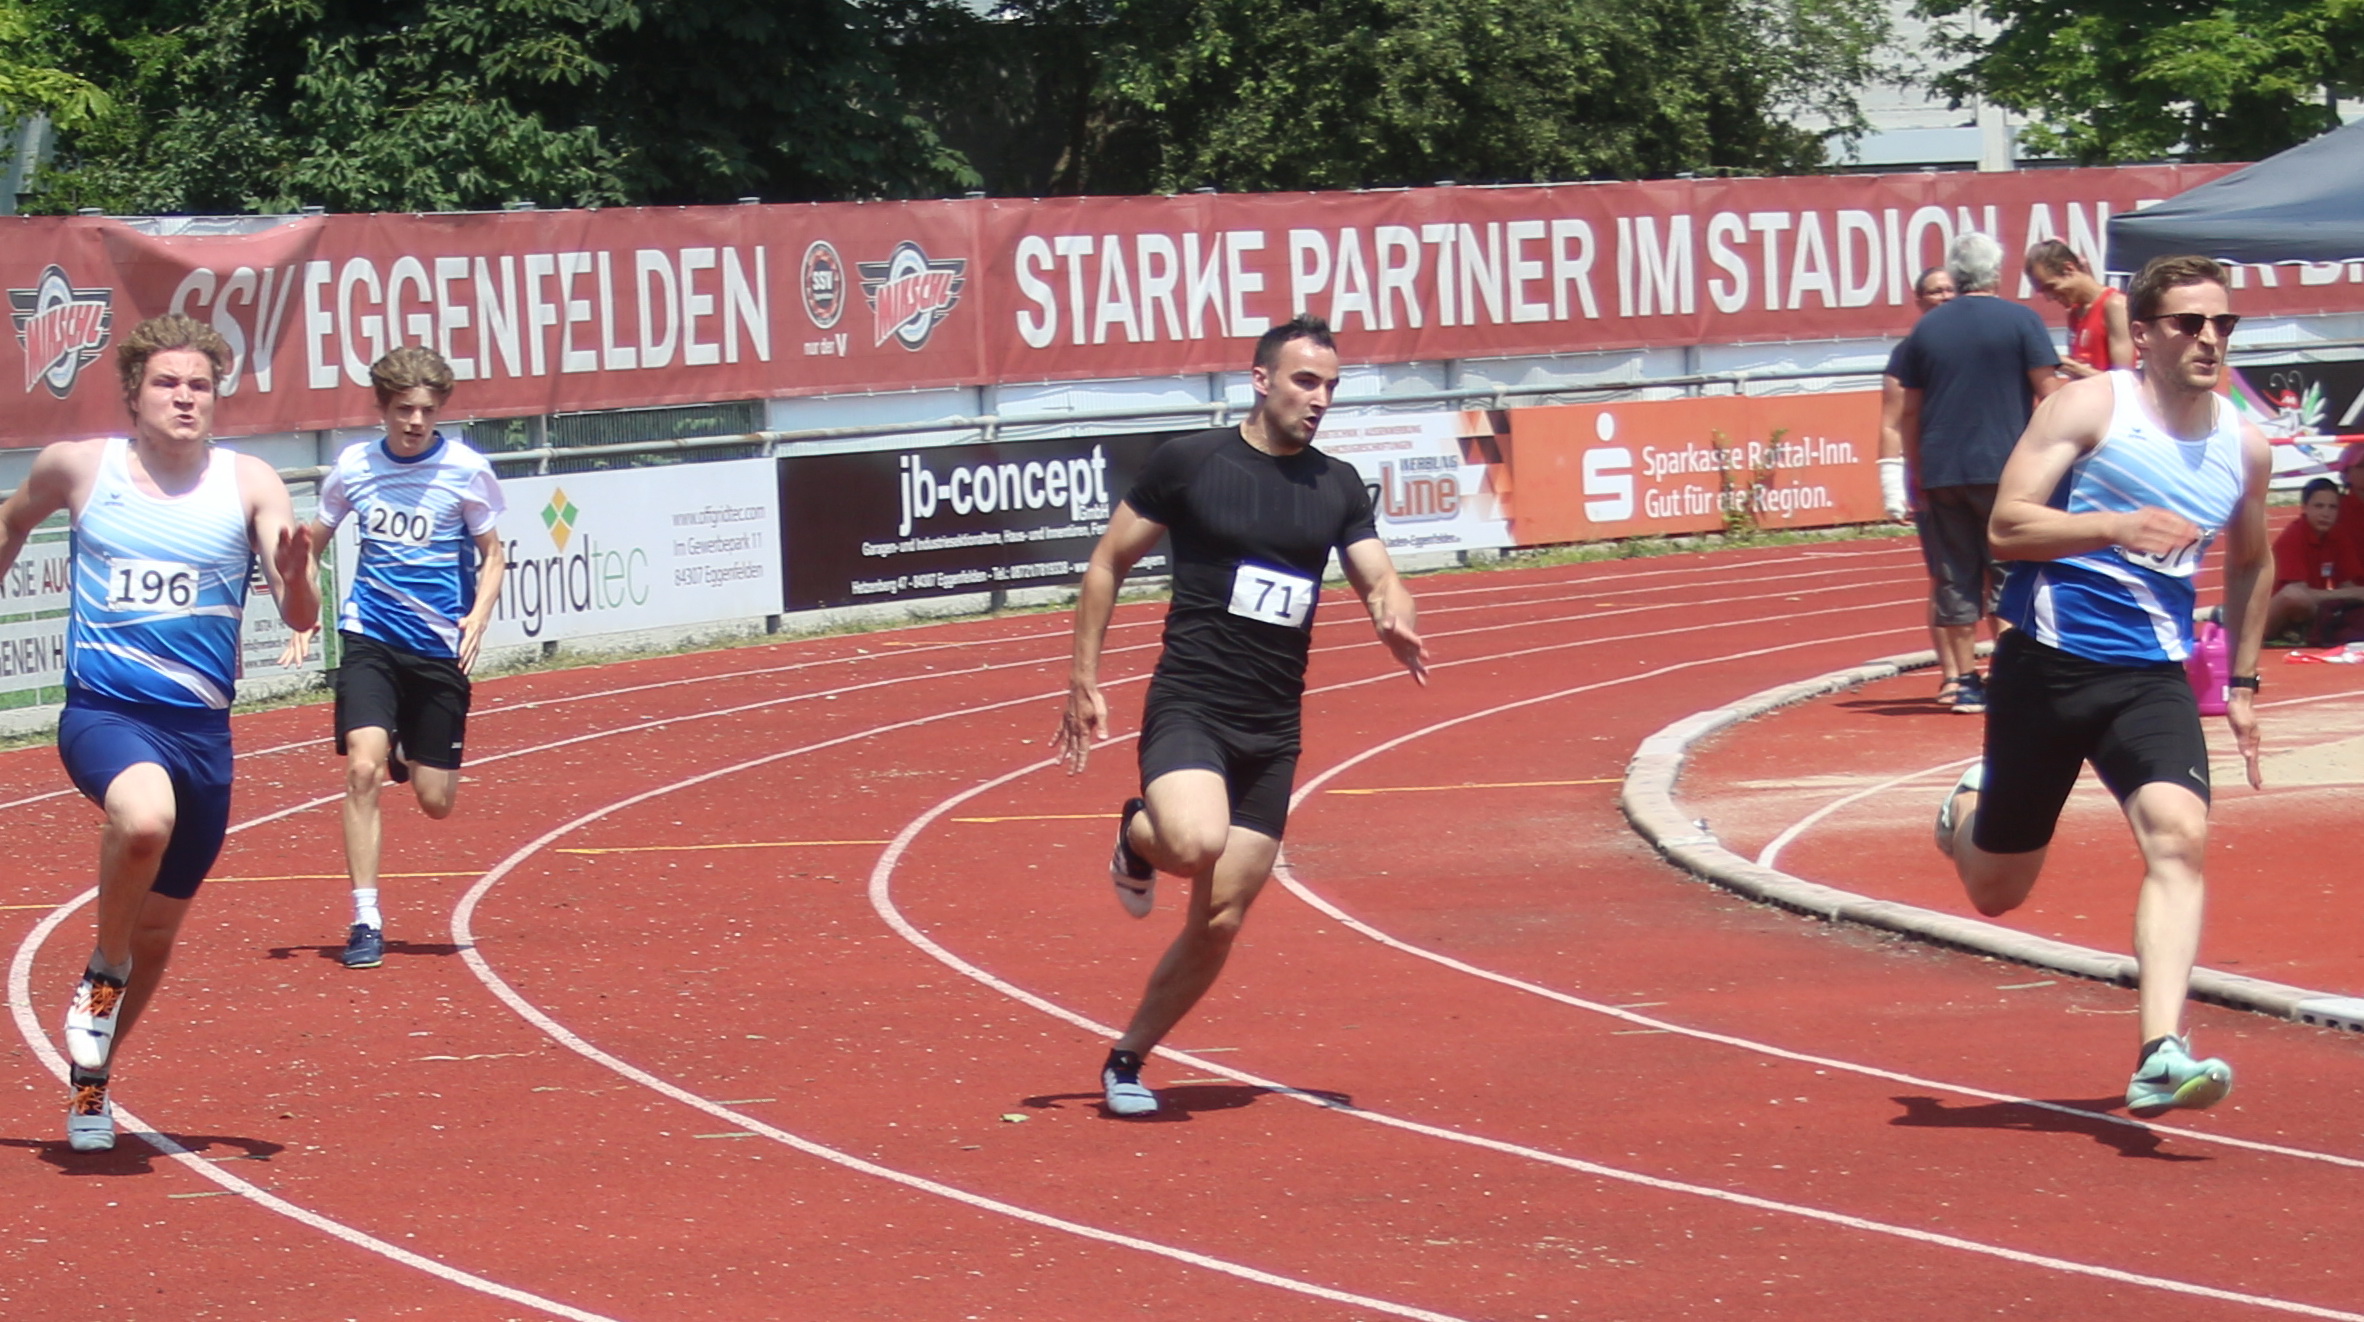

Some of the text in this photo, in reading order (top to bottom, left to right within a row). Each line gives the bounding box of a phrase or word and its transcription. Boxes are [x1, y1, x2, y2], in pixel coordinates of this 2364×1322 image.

[1015, 231, 1270, 349] STARKE
[1289, 218, 1599, 333] PARTNER
[1617, 214, 1694, 318] IM
[305, 245, 771, 389] EGGENFELDEN
[835, 333, 848, 357] V
[1642, 437, 1859, 482] Sparkasse Rottal-Inn.
[899, 444, 1108, 536] jb-concept
[1645, 488, 1681, 518] Gut
[1683, 485, 1713, 515] für
[1751, 480, 1832, 518] Region.
[371, 507, 428, 542] 200
[672, 505, 767, 528] www.offgridtec.com
[673, 531, 762, 558] Im Gewerbepark 11
[12, 560, 36, 598] SIE
[116, 568, 191, 607] 196
[476, 533, 649, 637] ffgridtec
[674, 562, 764, 588] 84307 Eggenfelden
[1254, 577, 1292, 619] 71
[0, 636, 46, 677] ENEN
